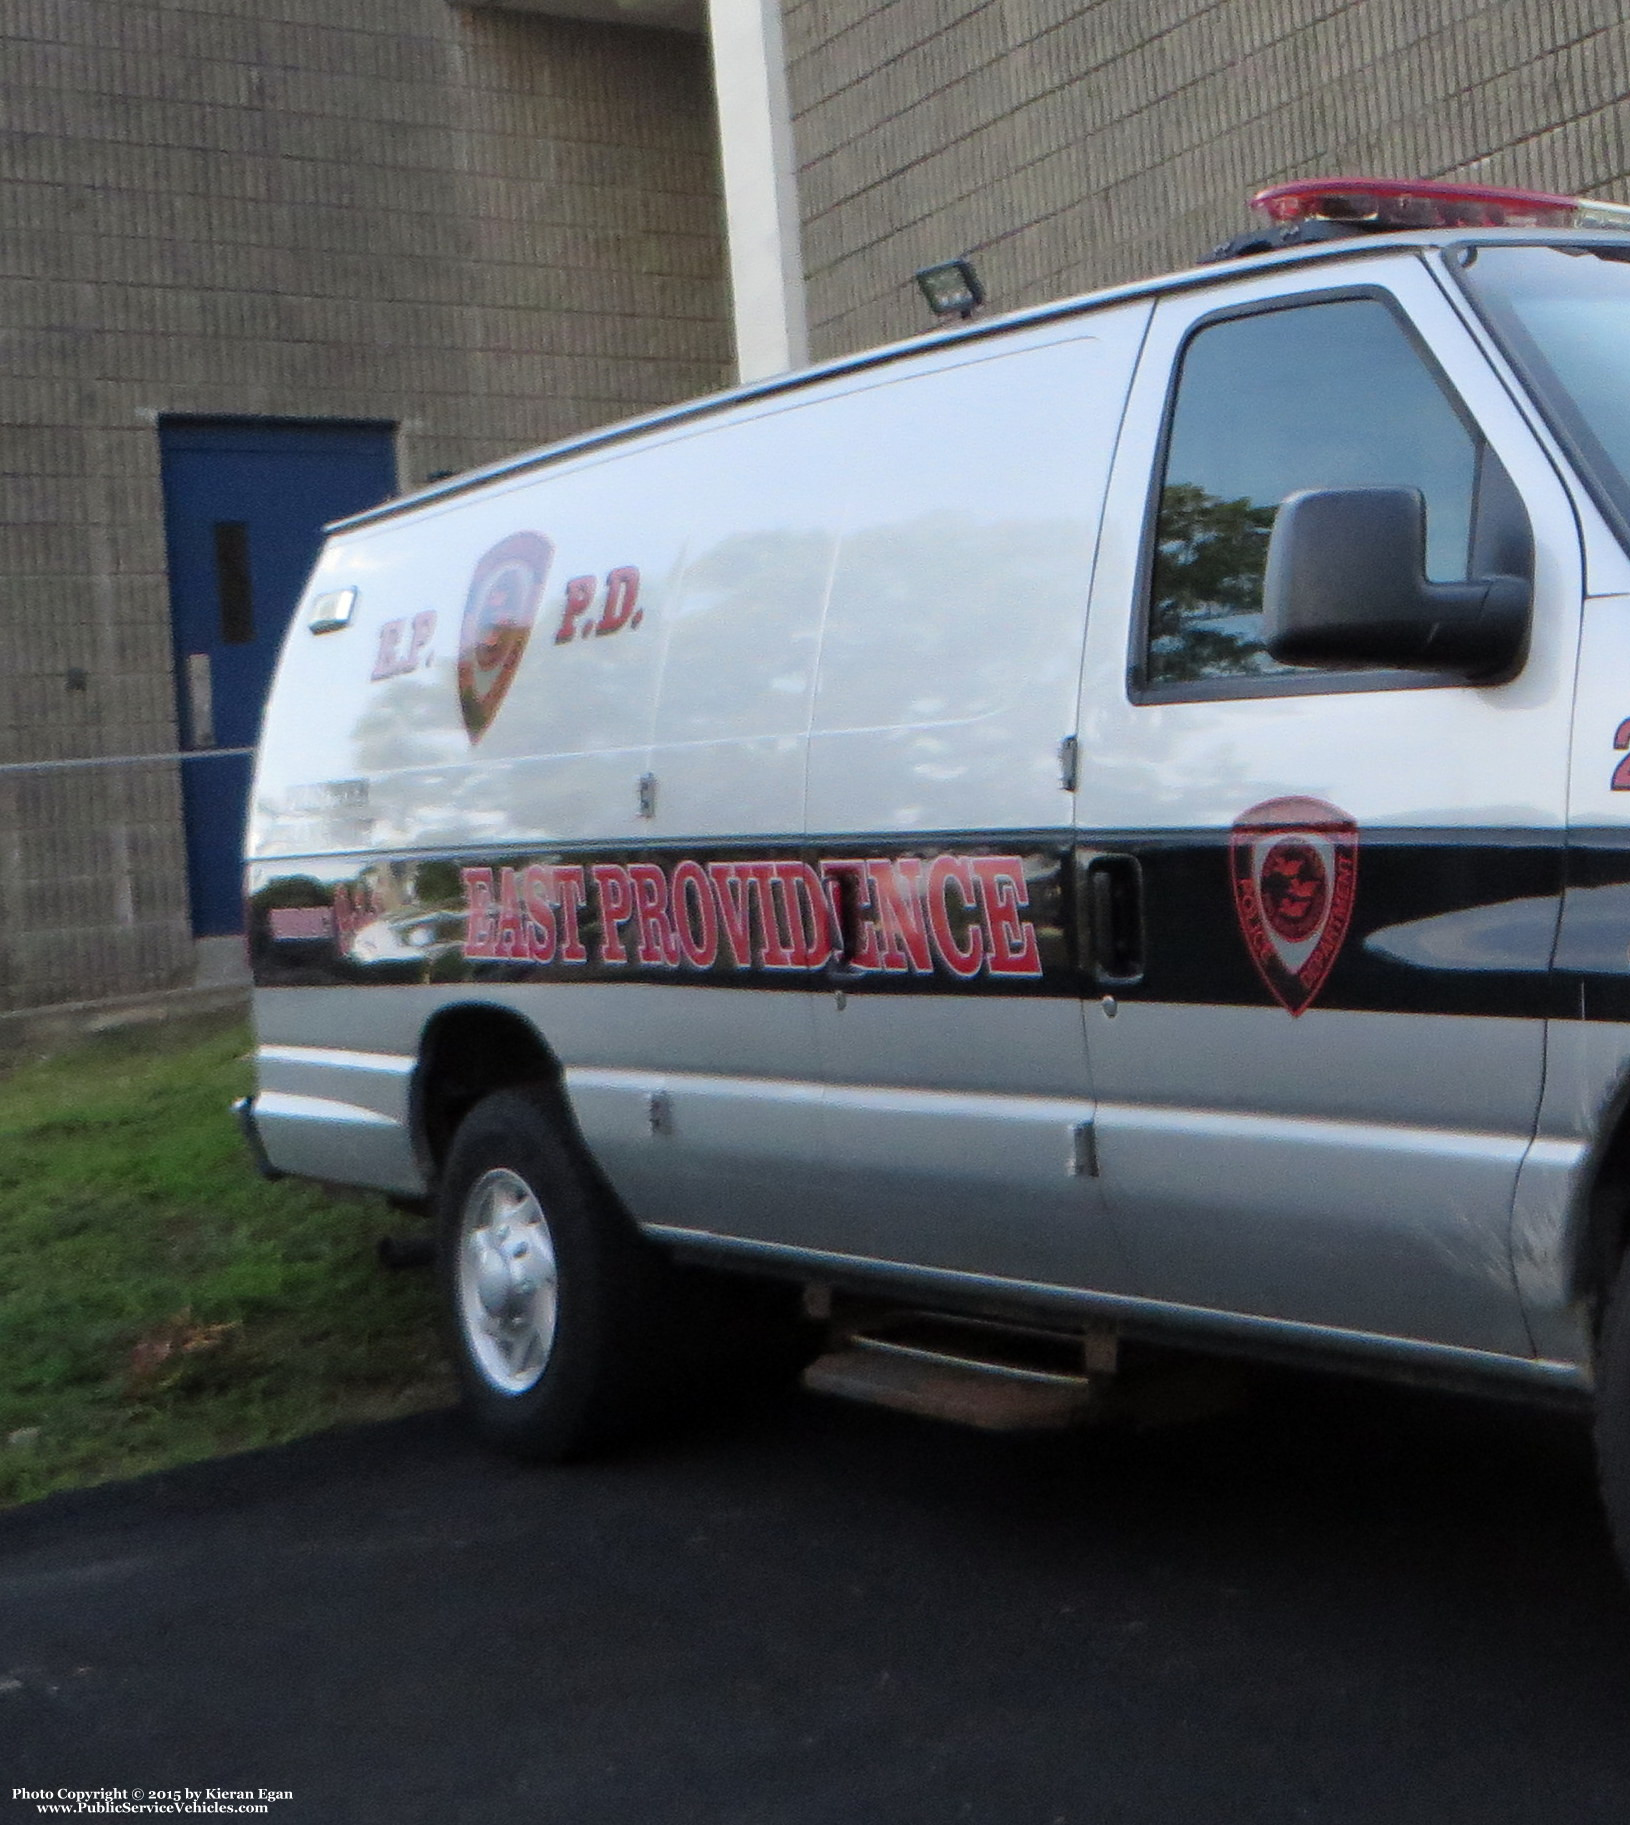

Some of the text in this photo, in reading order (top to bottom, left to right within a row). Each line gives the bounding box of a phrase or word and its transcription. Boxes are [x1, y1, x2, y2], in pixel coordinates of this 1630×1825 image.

[554, 565, 644, 645] P.D.
[462, 864, 588, 965] EAST
[590, 855, 1044, 978] PROVIDENCE
